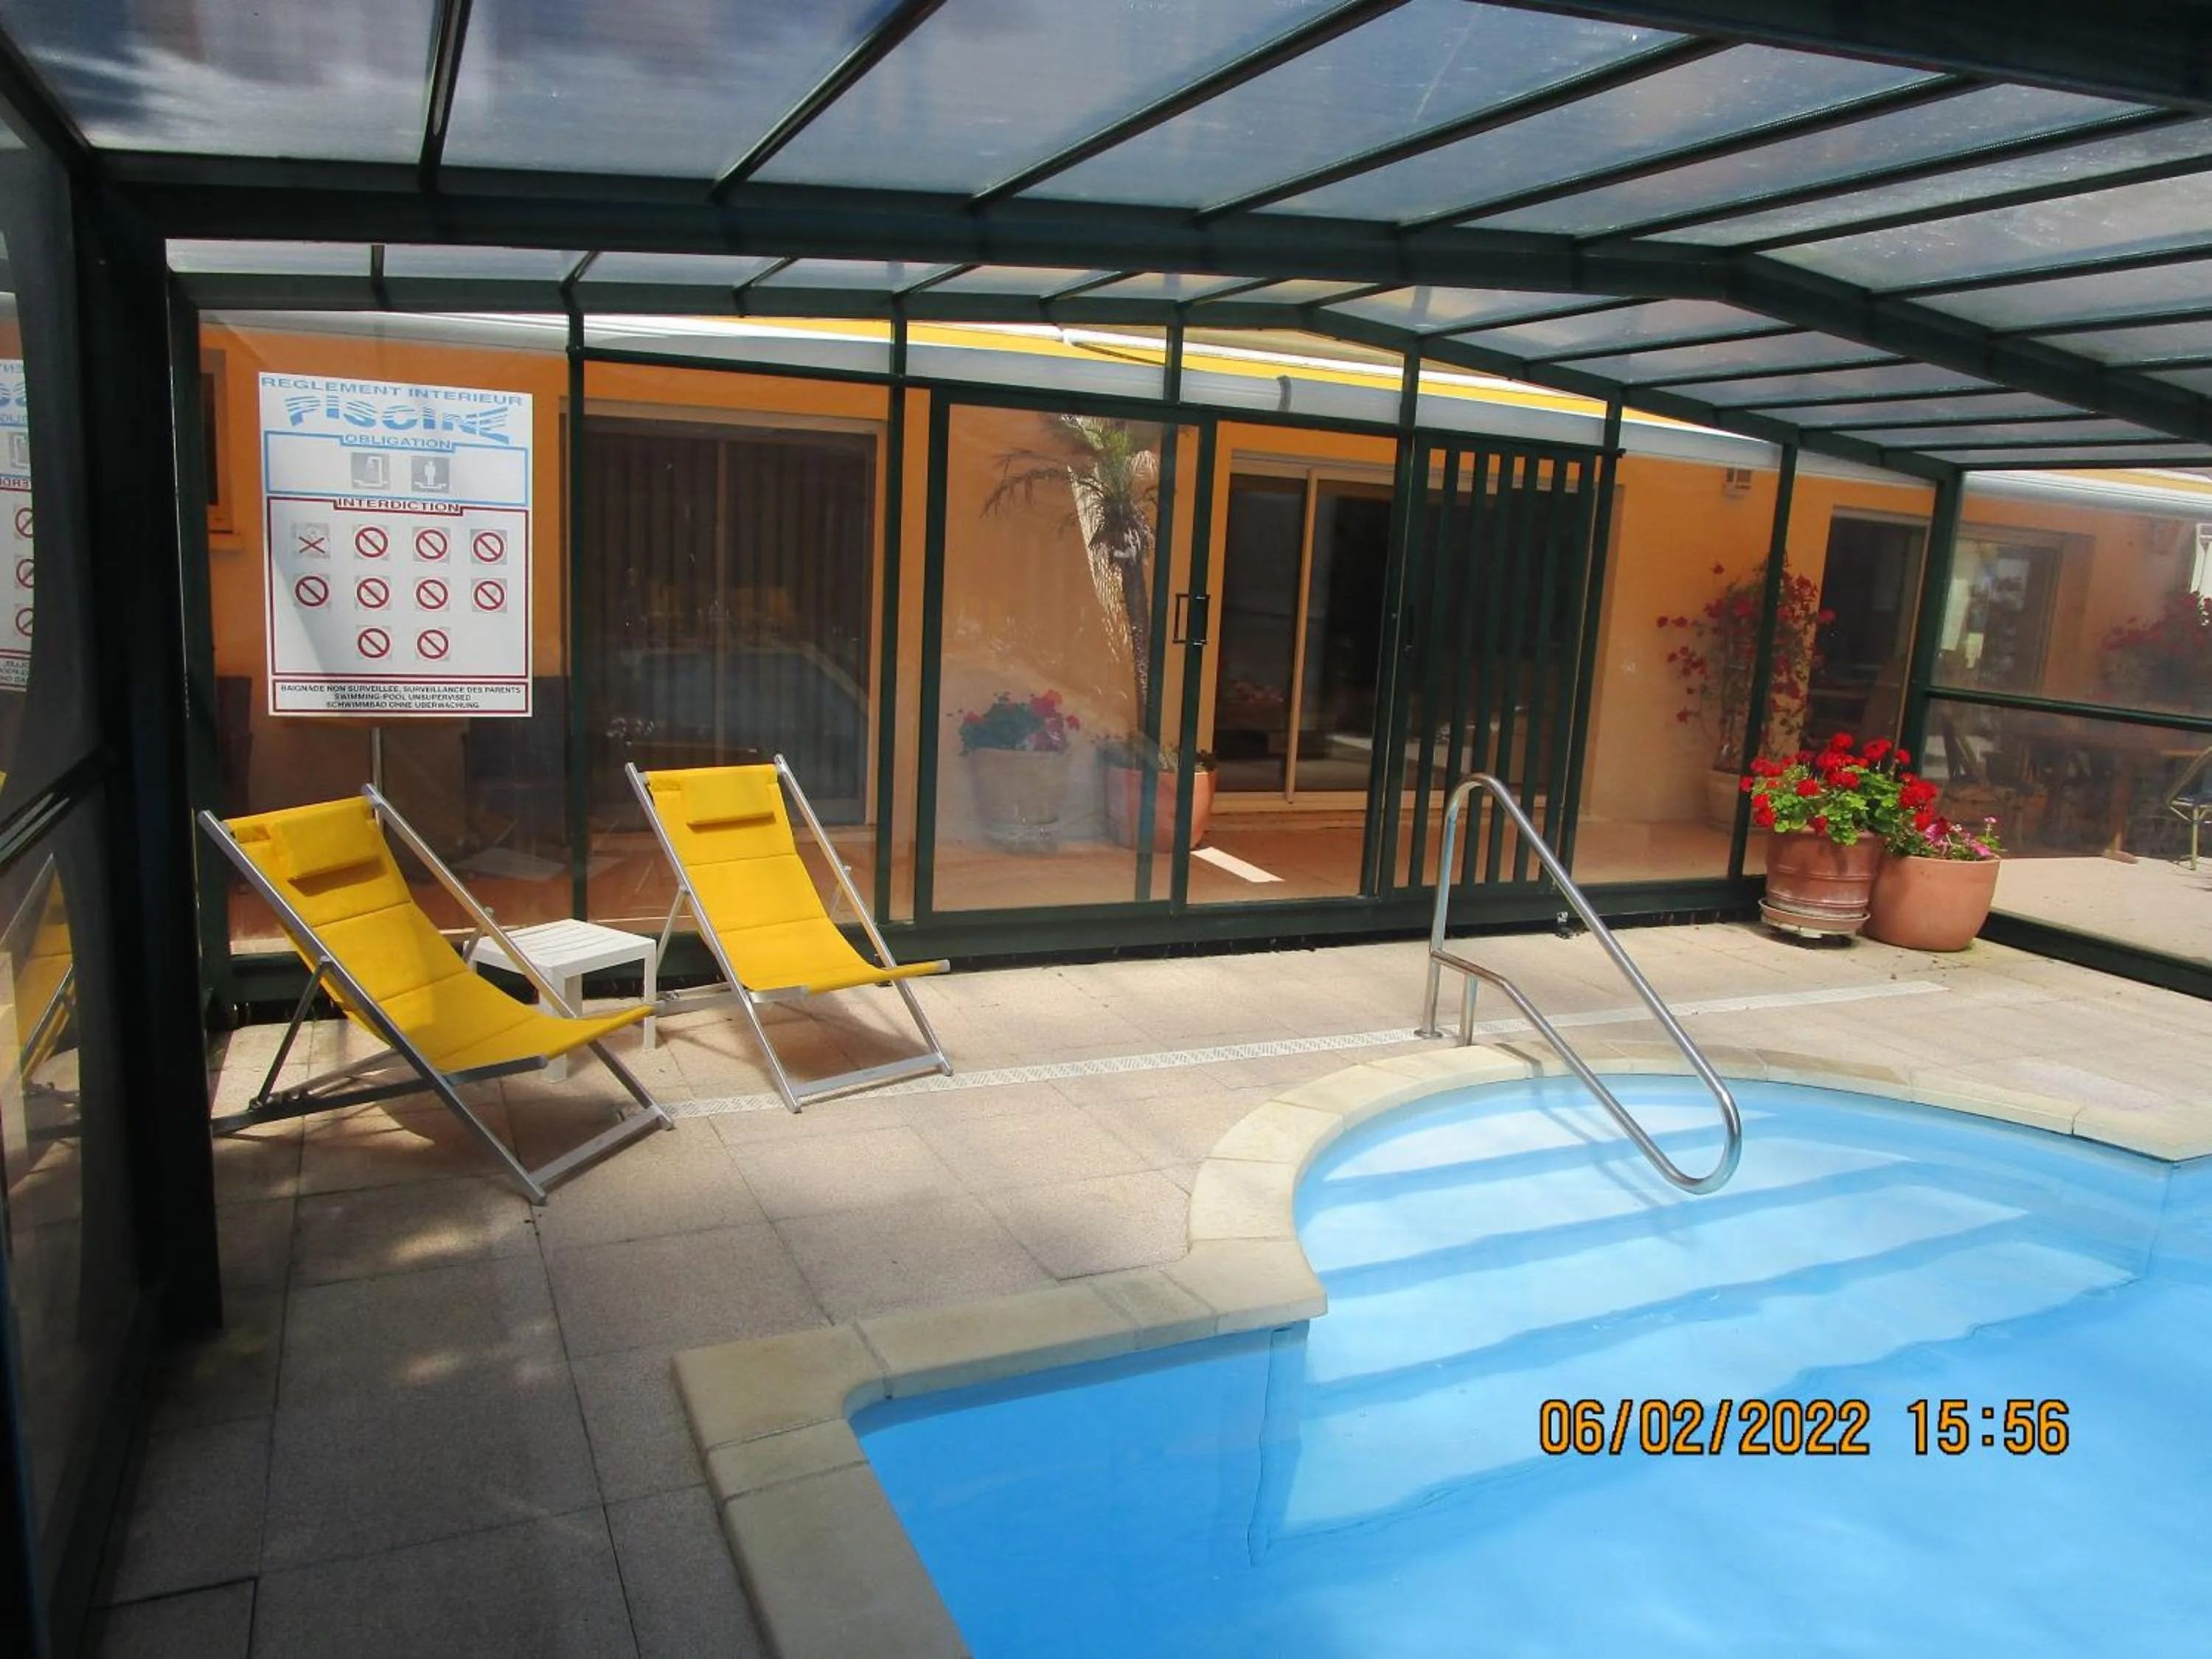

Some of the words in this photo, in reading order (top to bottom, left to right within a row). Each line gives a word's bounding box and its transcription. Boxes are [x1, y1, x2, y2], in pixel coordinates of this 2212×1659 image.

[261, 376, 402, 397] REGLEMENT
[408, 388, 523, 406] INTERIEUR
[343, 434, 451, 449] OBLIGATION
[338, 497, 460, 512] INTERDICTION
[467, 686, 483, 694] DES
